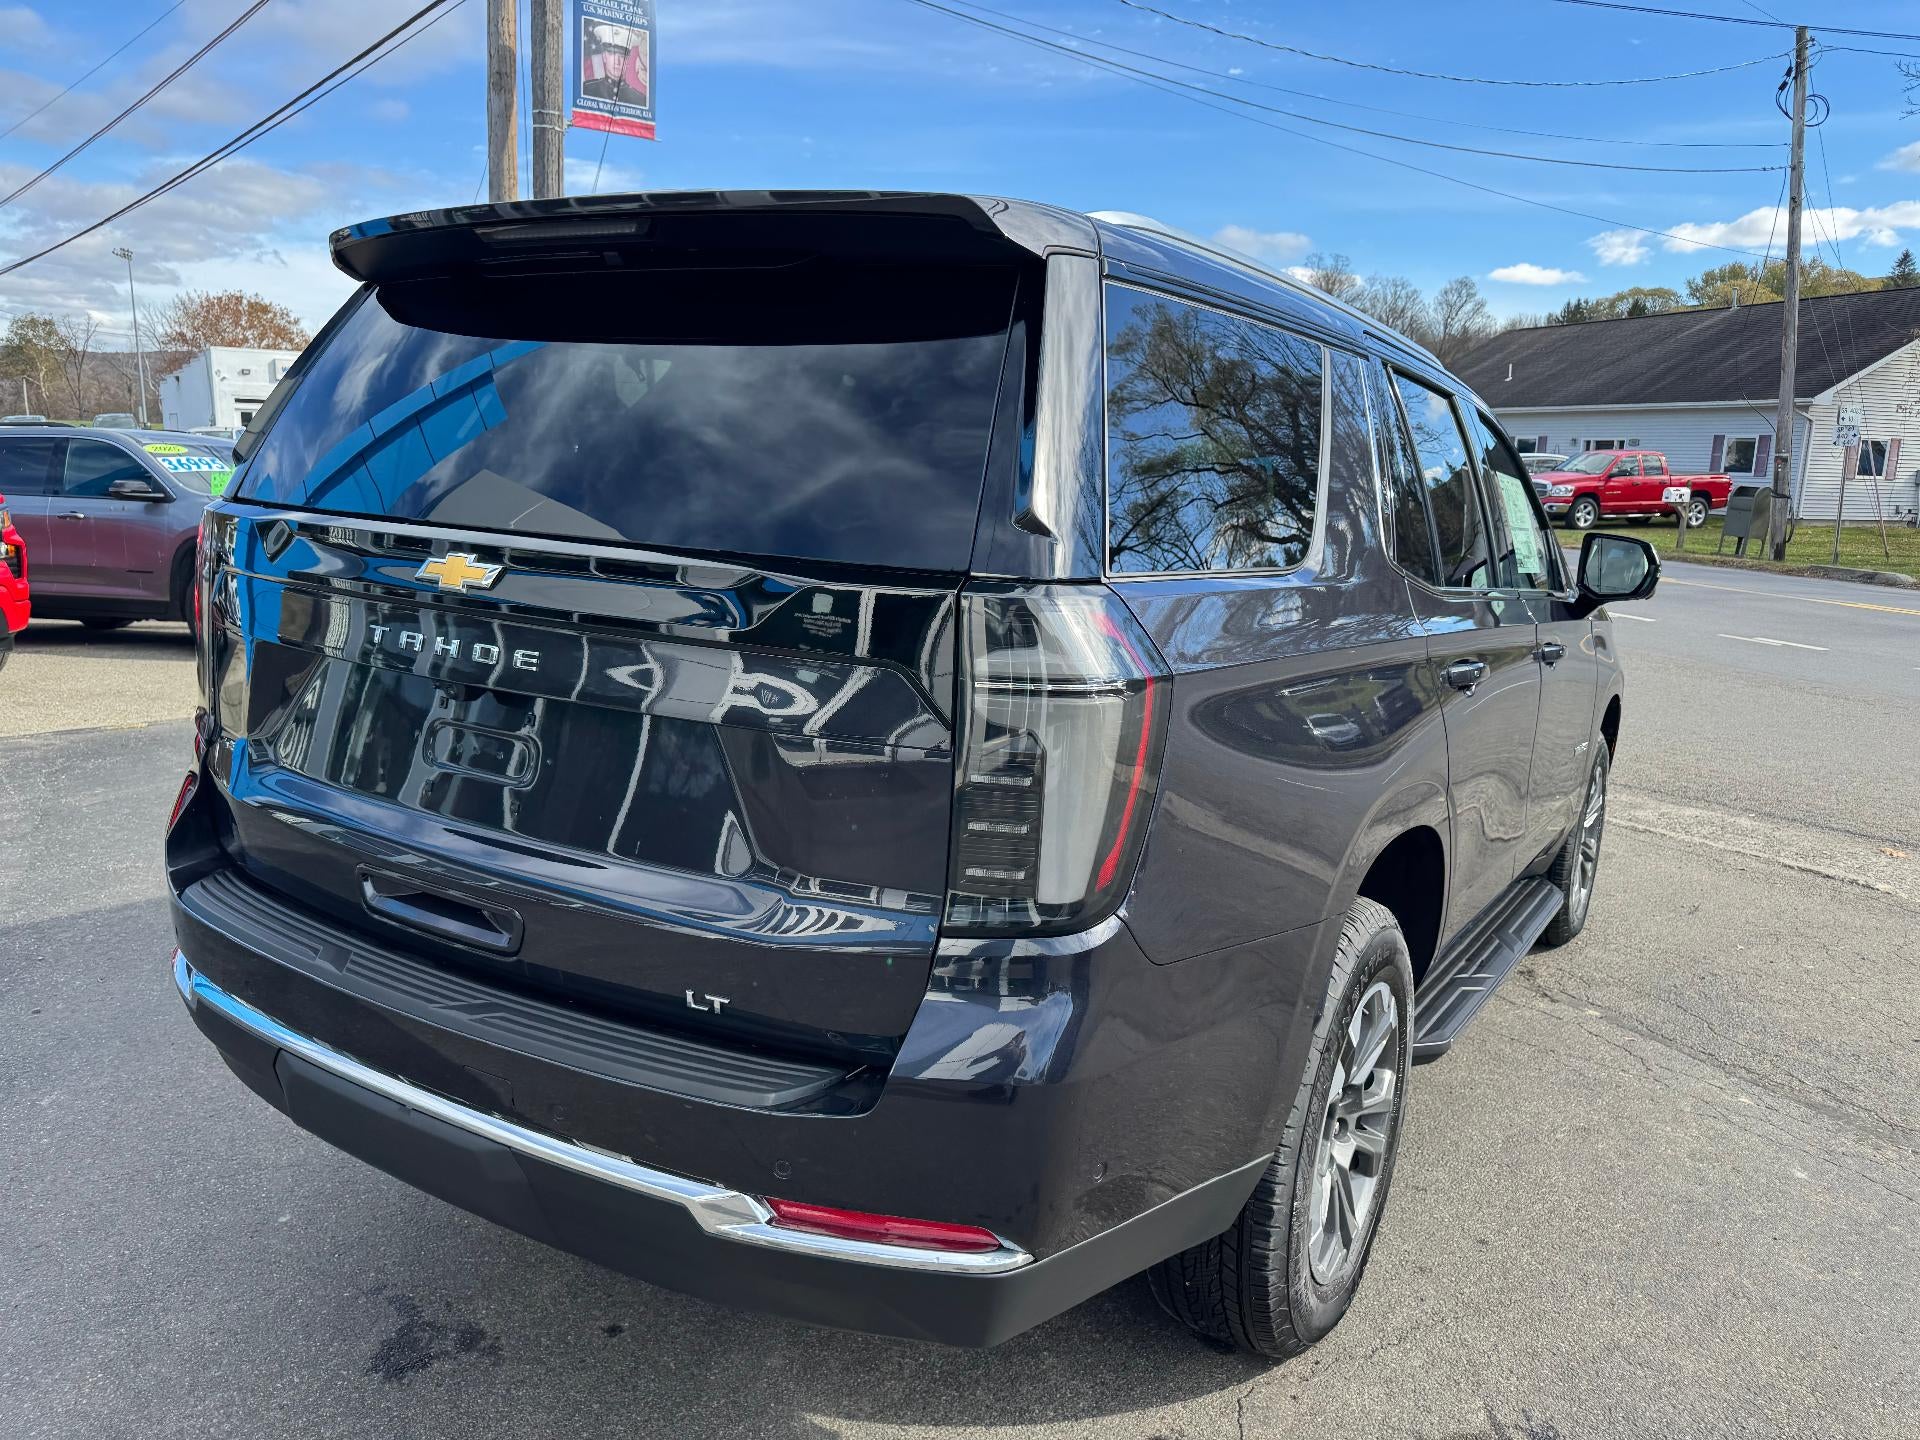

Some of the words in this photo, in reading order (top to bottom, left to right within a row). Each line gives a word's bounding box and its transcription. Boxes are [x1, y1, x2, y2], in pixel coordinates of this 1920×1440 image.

[597, 7, 624, 19] MARINE
[625, 14, 648, 25] CORPS
[161, 456, 225, 471] 36995
[369, 624, 540, 672] TAHOE
[685, 989, 730, 1015] LT
